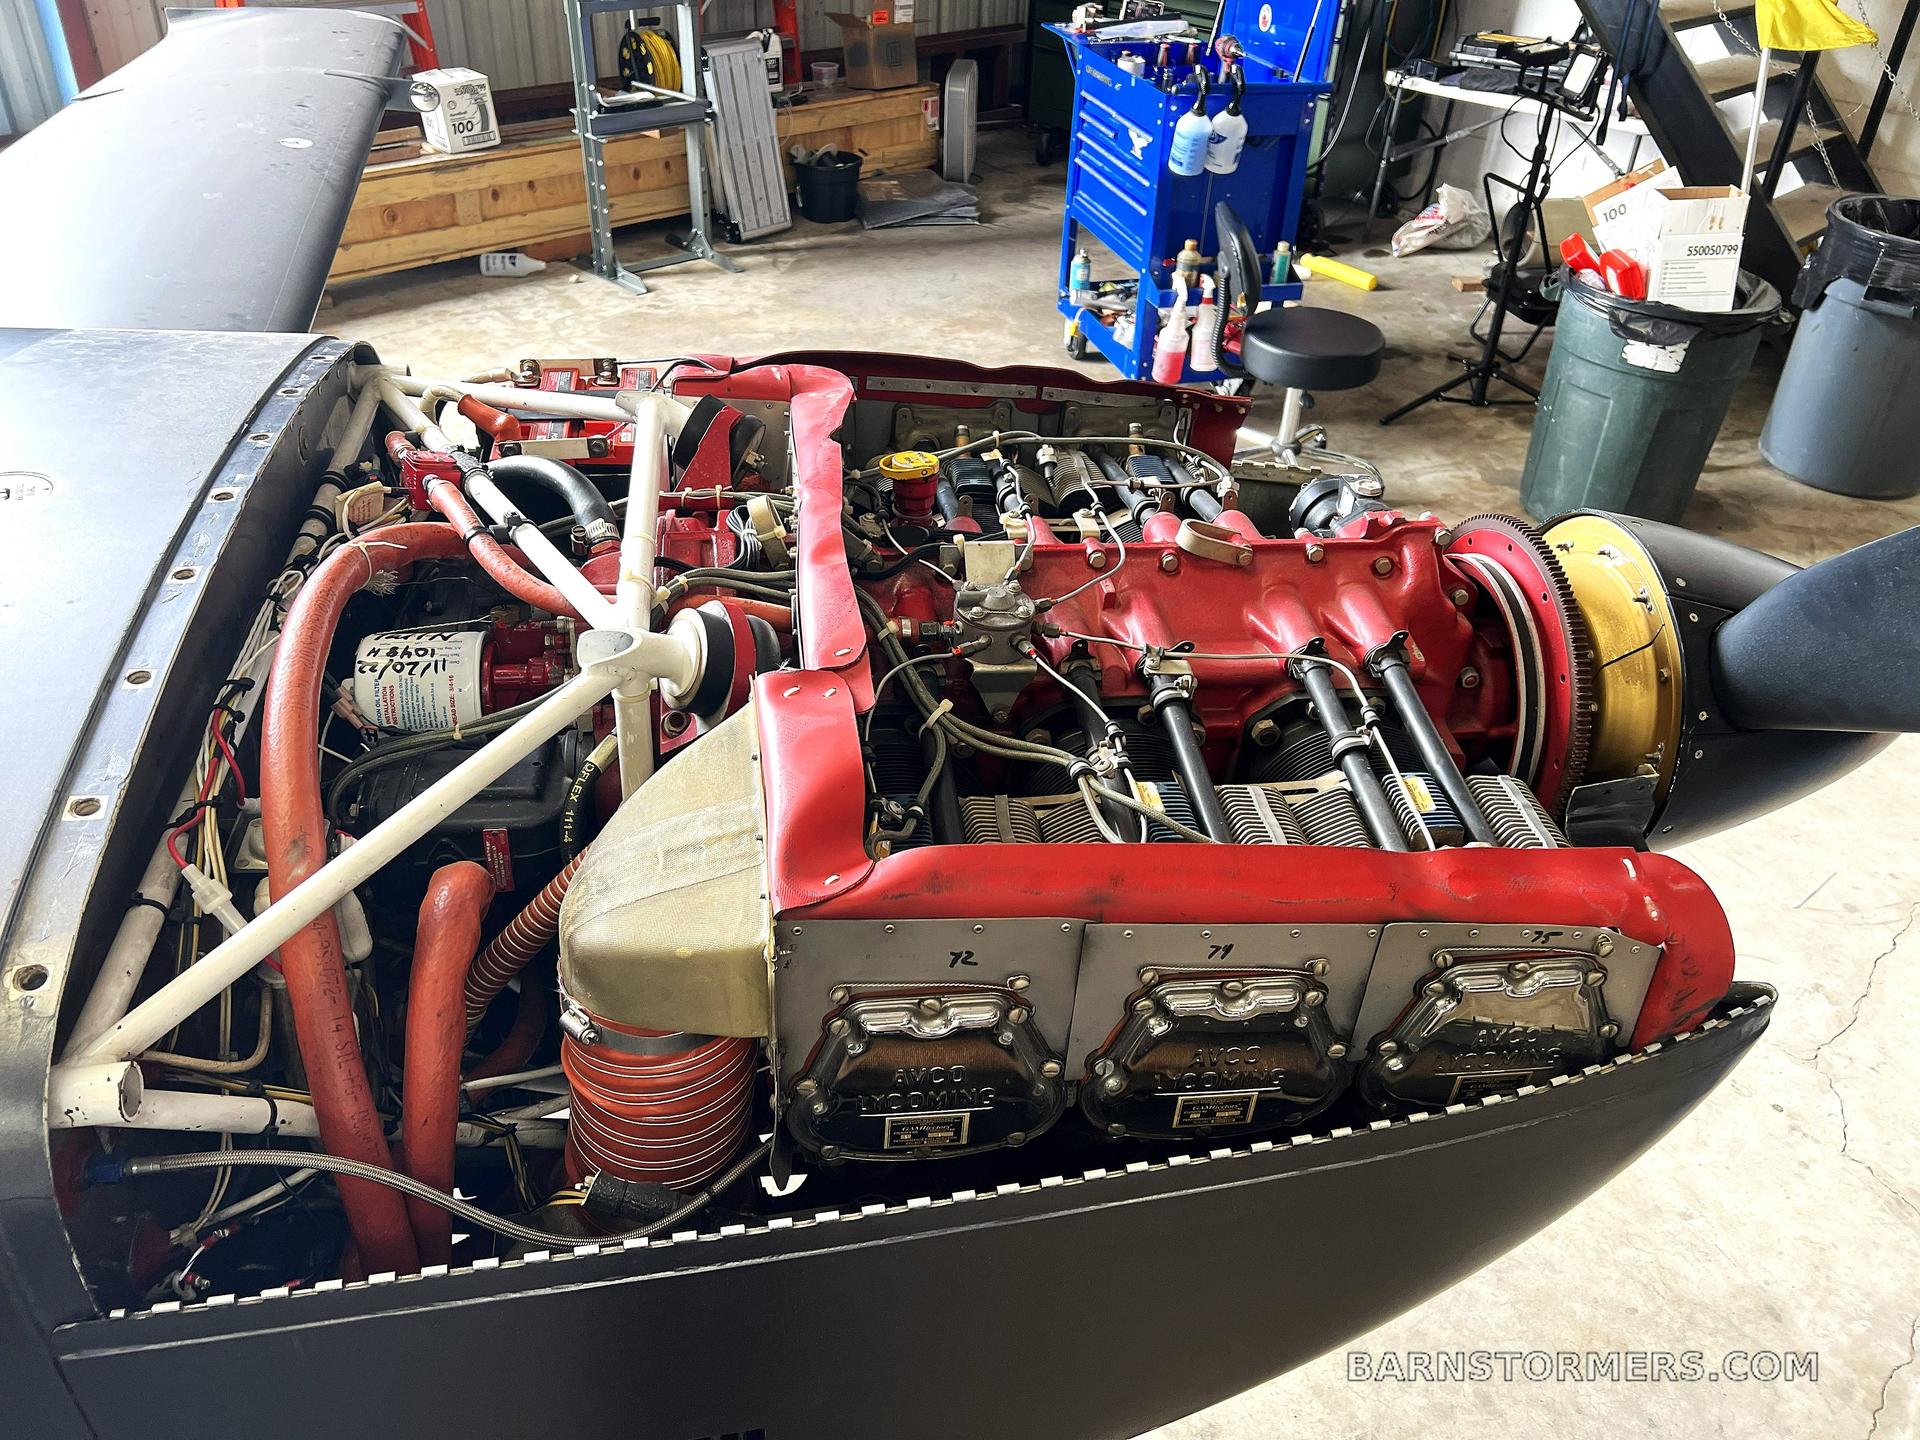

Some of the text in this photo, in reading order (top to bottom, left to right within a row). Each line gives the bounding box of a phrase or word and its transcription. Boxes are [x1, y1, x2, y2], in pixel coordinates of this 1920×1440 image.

[452, 120, 474, 135] 100
[1603, 203, 1627, 223] 100
[1686, 244, 1739, 257] 550050799
[366, 647, 381, 658] H
[386, 645, 436, 660] 1048
[357, 658, 446, 681] 11/20/22
[381, 686, 391, 725] INSTALLATION
[389, 685, 398, 725] INSTRUCTIONS
[562, 809, 575, 843] 111-4
[1529, 929, 1563, 945] 75
[948, 949, 979, 969] 72
[1472, 1026, 1542, 1047] AVCO
[1187, 1045, 1262, 1068] AVCO
[1434, 1047, 1562, 1070] LYCOMING
[896, 1064, 967, 1089] AVCO
[1155, 1066, 1286, 1091] LYCOMING
[857, 1087, 996, 1111] LYCOMING
